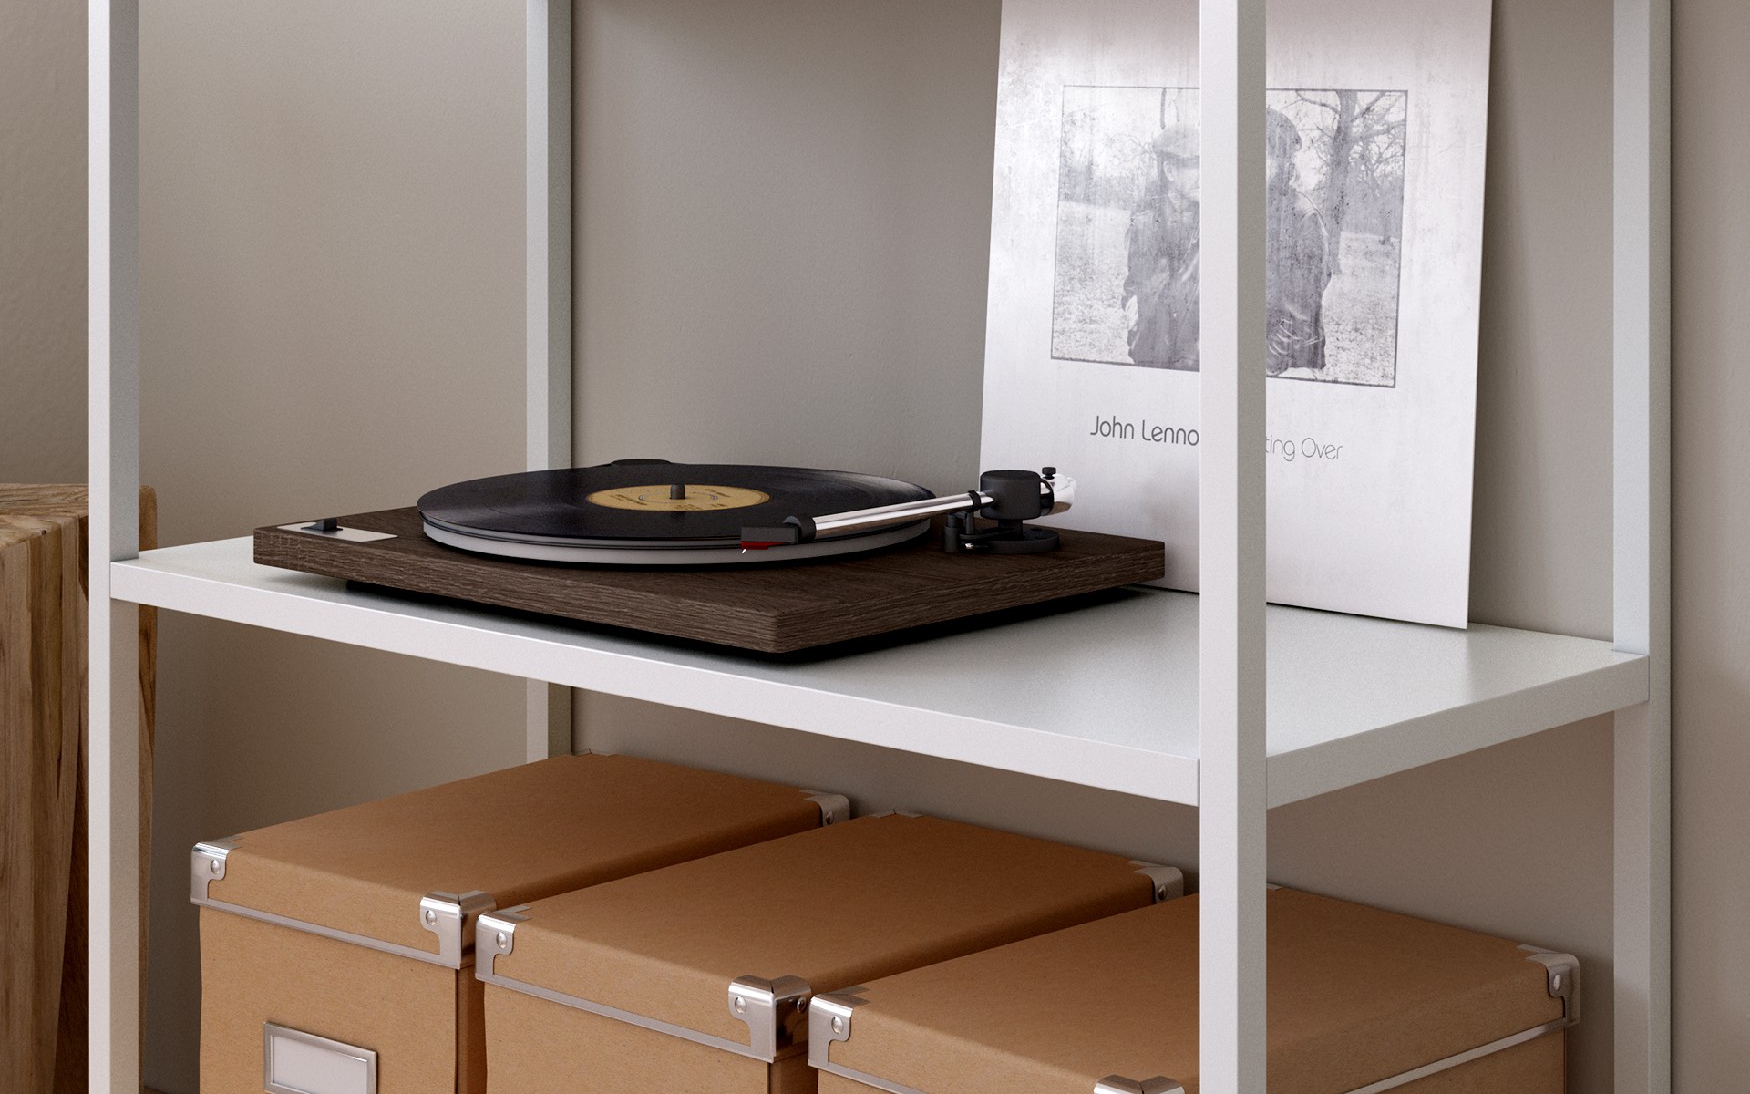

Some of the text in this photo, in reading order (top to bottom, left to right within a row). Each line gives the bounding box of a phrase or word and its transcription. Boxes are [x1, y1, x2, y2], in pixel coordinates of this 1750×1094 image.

[1090, 415, 1135, 440] John
[1142, 419, 1199, 446] Lenno
[1301, 437, 1344, 460] Over
